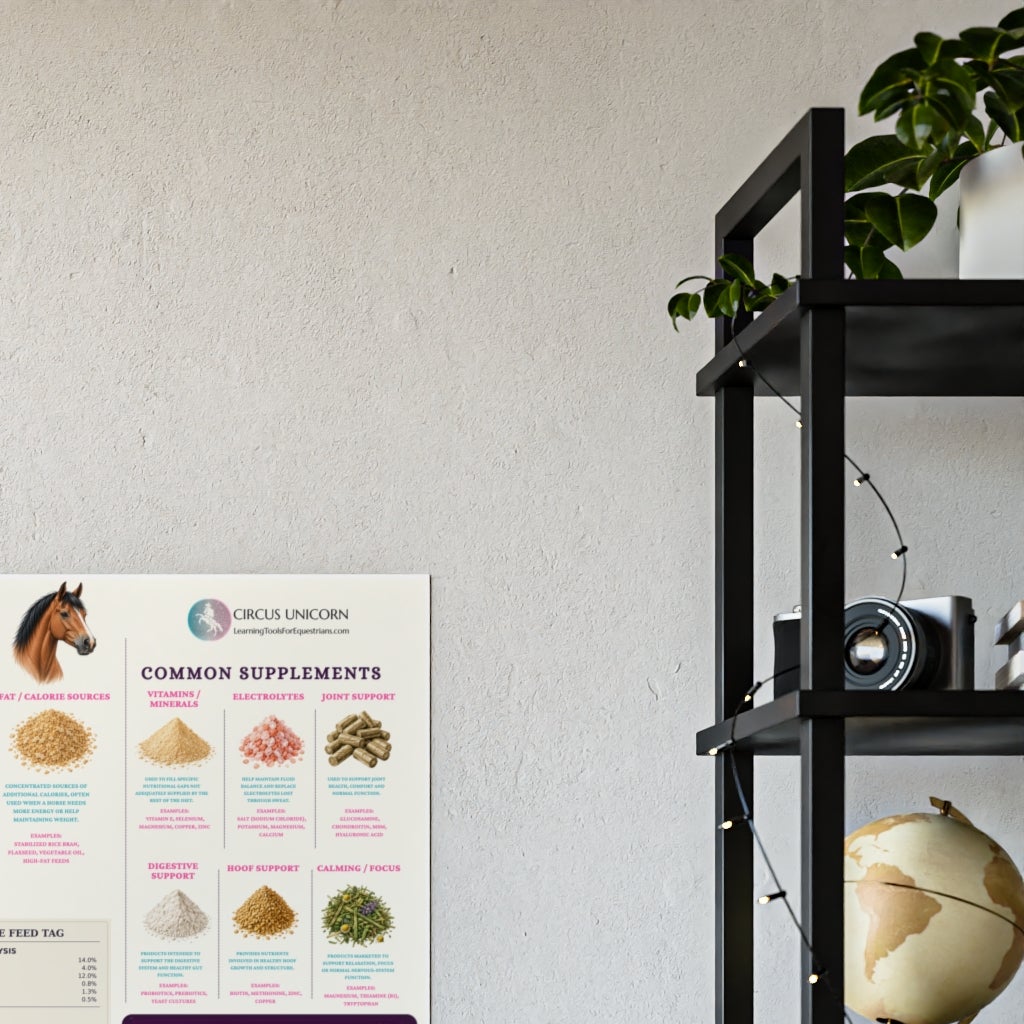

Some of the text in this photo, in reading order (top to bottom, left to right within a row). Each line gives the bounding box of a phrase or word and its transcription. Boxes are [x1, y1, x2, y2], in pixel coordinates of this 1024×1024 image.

[233, 608, 349, 621] CIRCUS UNICORN
[233, 627, 350, 637] LearningToolsForEquestrians.com
[141, 666, 381, 680] COMMON SUPPLEMENTS
[18, 691, 23, 702] /
[24, 693, 65, 701] CALORIE
[67, 693, 111, 701] SOURCES
[147, 689, 201, 700] VITAMINS /
[232, 693, 305, 701] ELECTROLYTES
[320, 693, 396, 703] JOINT SUPPORT
[150, 700, 199, 708] MINERALS
[148, 862, 199, 870] DIGESTIVE
[227, 864, 300, 872] HOOF SUPPORT
[316, 863, 401, 873] CALMING / FOCUS
[151, 872, 196, 880] SUPPORT
[9, 928, 39, 938] FEED
[41, 928, 64, 938] TAG
